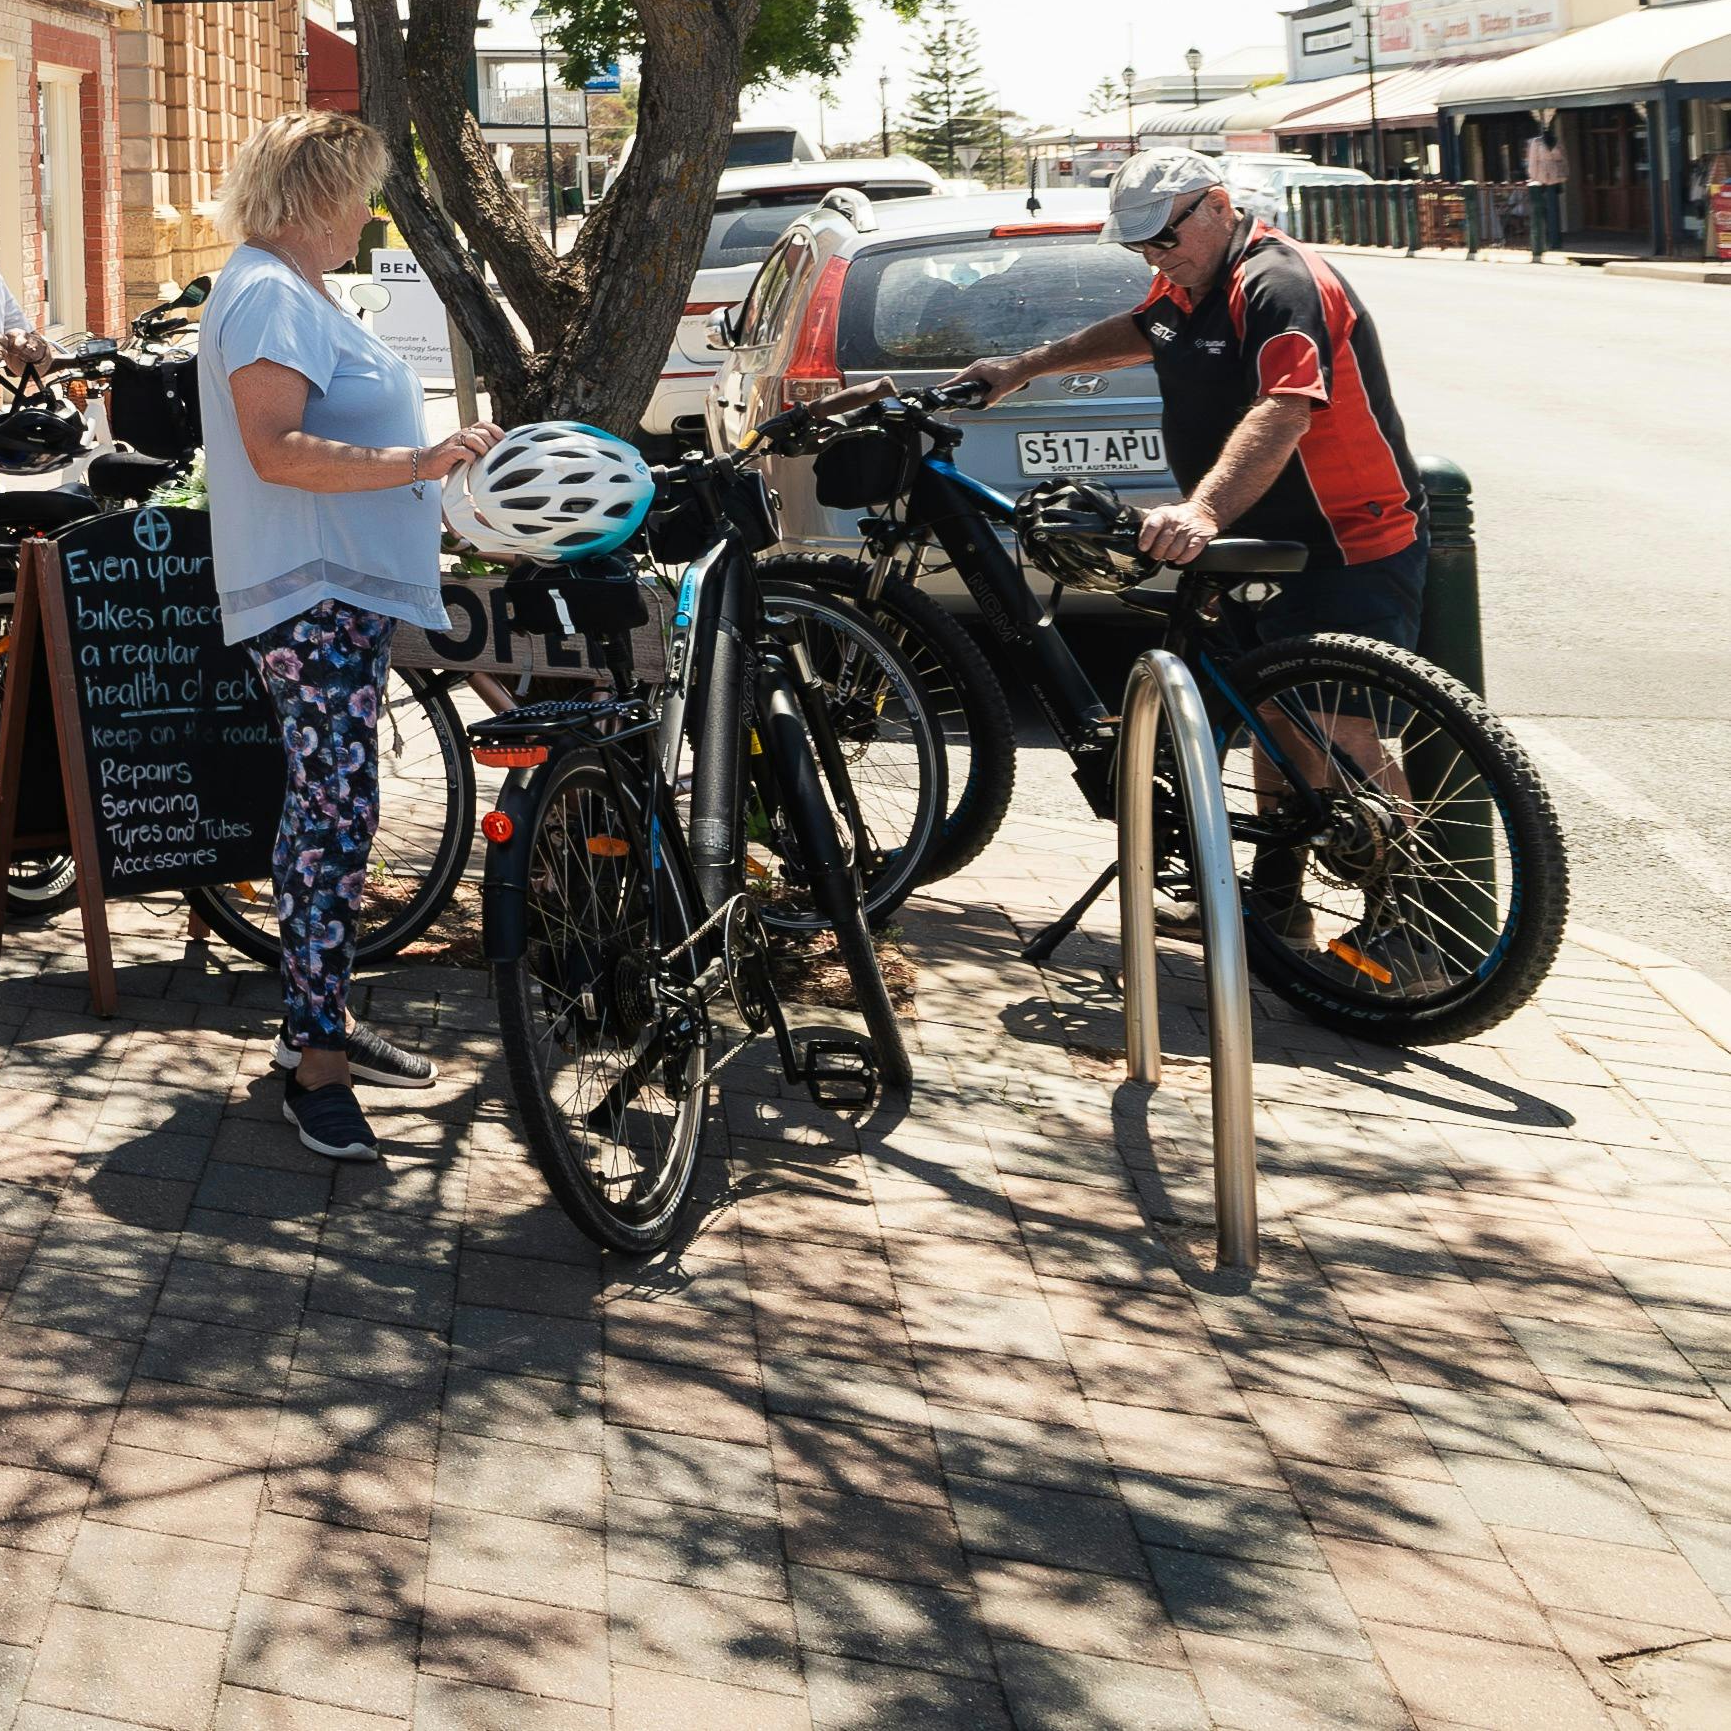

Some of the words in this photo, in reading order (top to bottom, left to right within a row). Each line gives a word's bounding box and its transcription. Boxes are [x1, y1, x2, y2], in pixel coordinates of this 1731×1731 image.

[388, 345, 426, 353] chnology
[409, 354, 444, 362] Tutoring
[1051, 464, 1083, 472] SOUTH
[1086, 463, 1139, 471] AUSTRALIA
[65, 549, 139, 584] Even
[147, 554, 214, 594] your
[76, 595, 154, 631] bikes
[80, 644, 100, 667] a
[110, 636, 201, 676] regular
[85, 670, 170, 708] health
[150, 725, 176, 744] on
[100, 758, 193, 789] Repairs
[101, 793, 200, 823] Servicing
[106, 822, 163, 853] Tyres
[166, 824, 195, 843] and
[200, 819, 252, 840] Tubes
[111, 848, 218, 878] Accessories
